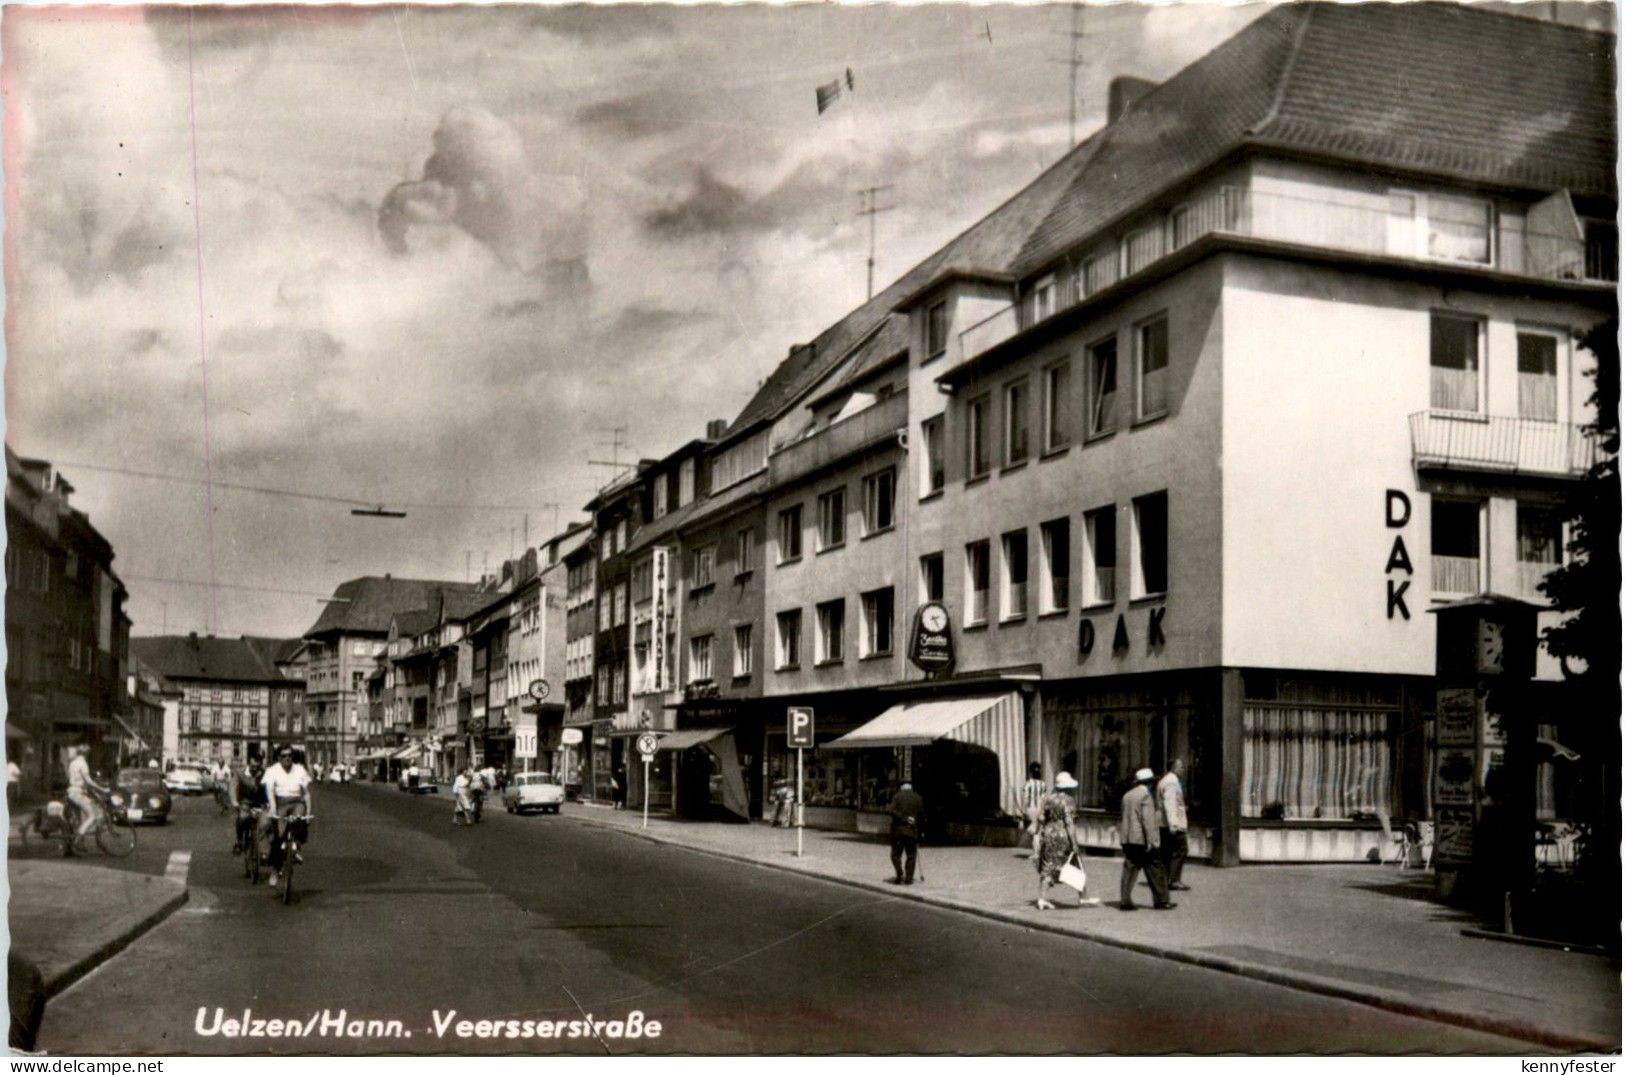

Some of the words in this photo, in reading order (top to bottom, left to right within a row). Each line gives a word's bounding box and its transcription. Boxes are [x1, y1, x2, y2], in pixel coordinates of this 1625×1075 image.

[1385, 489, 1414, 621] DAK
[1079, 607, 1167, 655] DAK
[793, 712, 809, 735] P
